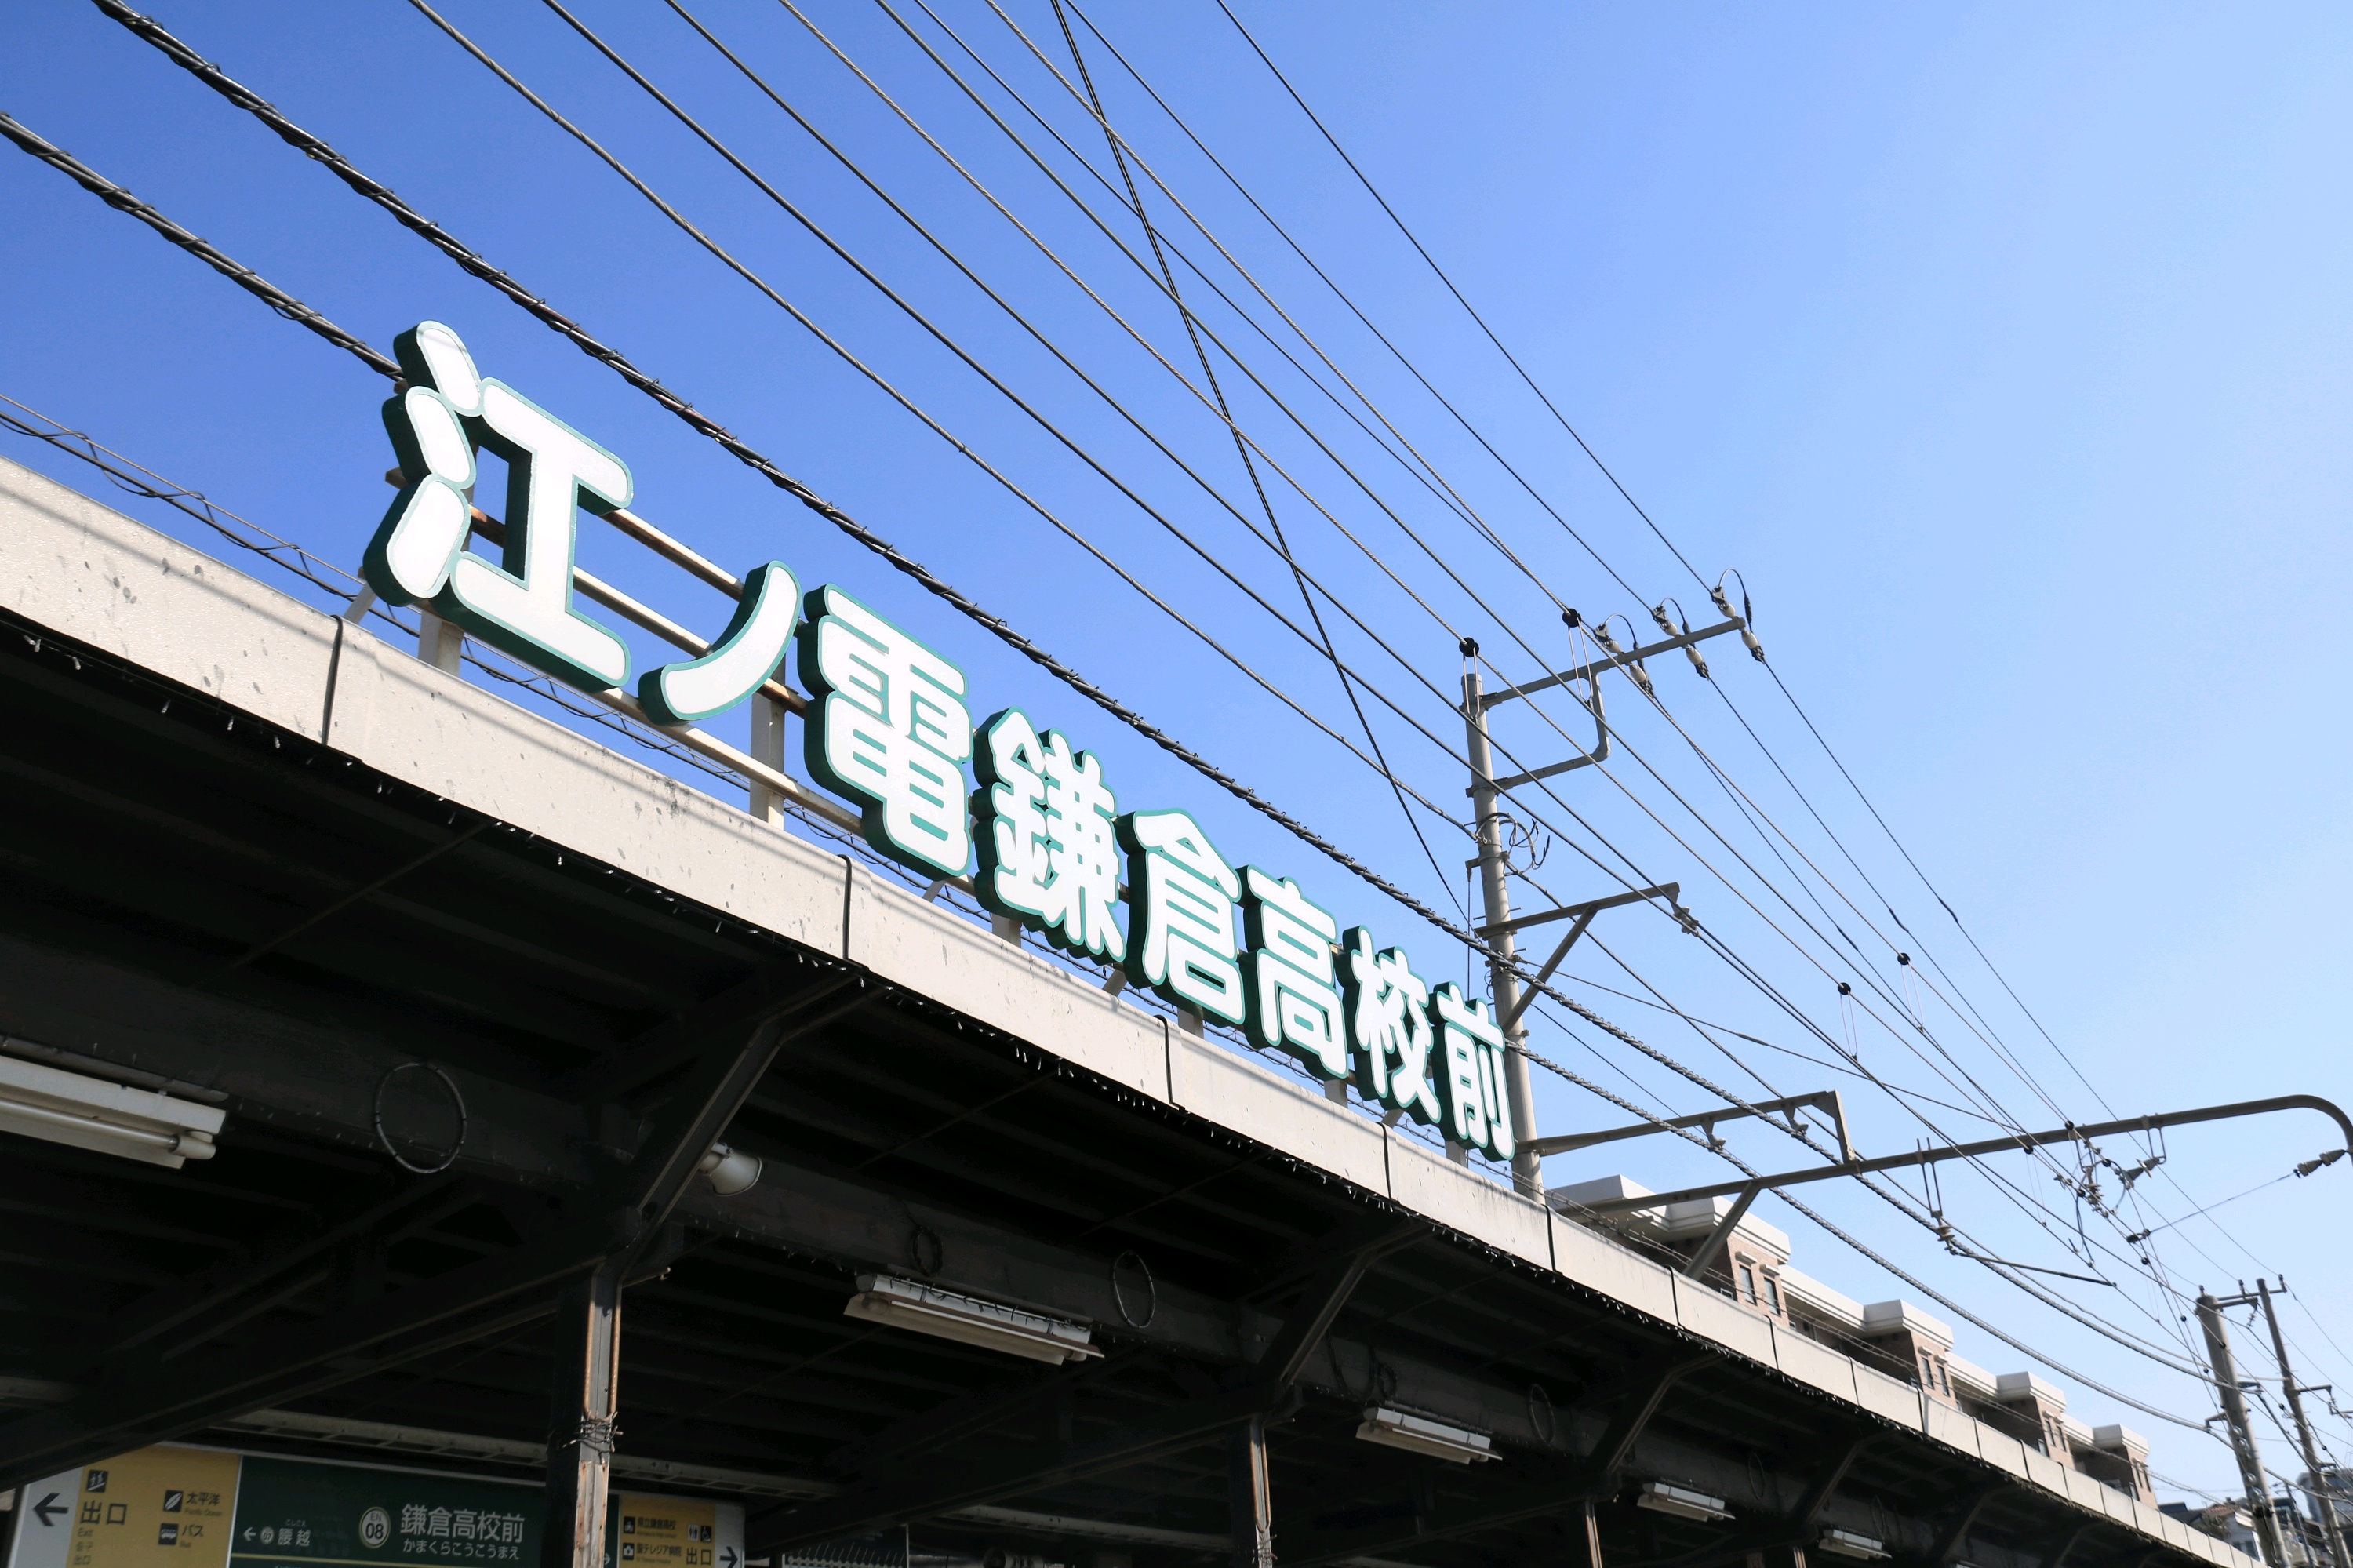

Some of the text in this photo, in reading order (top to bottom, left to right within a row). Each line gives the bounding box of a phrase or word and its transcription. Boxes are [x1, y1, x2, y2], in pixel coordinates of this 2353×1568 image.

[362, 320, 1515, 1162] 江ノ電鎌倉高校前
[186, 1491, 221, 1506] 太平洋
[80, 1500, 128, 1526] 出口
[370, 1512, 382, 1521] EN
[182, 1525, 204, 1537] バス
[365, 1523, 384, 1540] 08
[400, 1503, 525, 1544] 鎌倉高校前
[277, 1527, 311, 1547] 腰越
[402, 1538, 519, 1561] かまくらこうこうまえ
[686, 1547, 711, 1566] 出口
